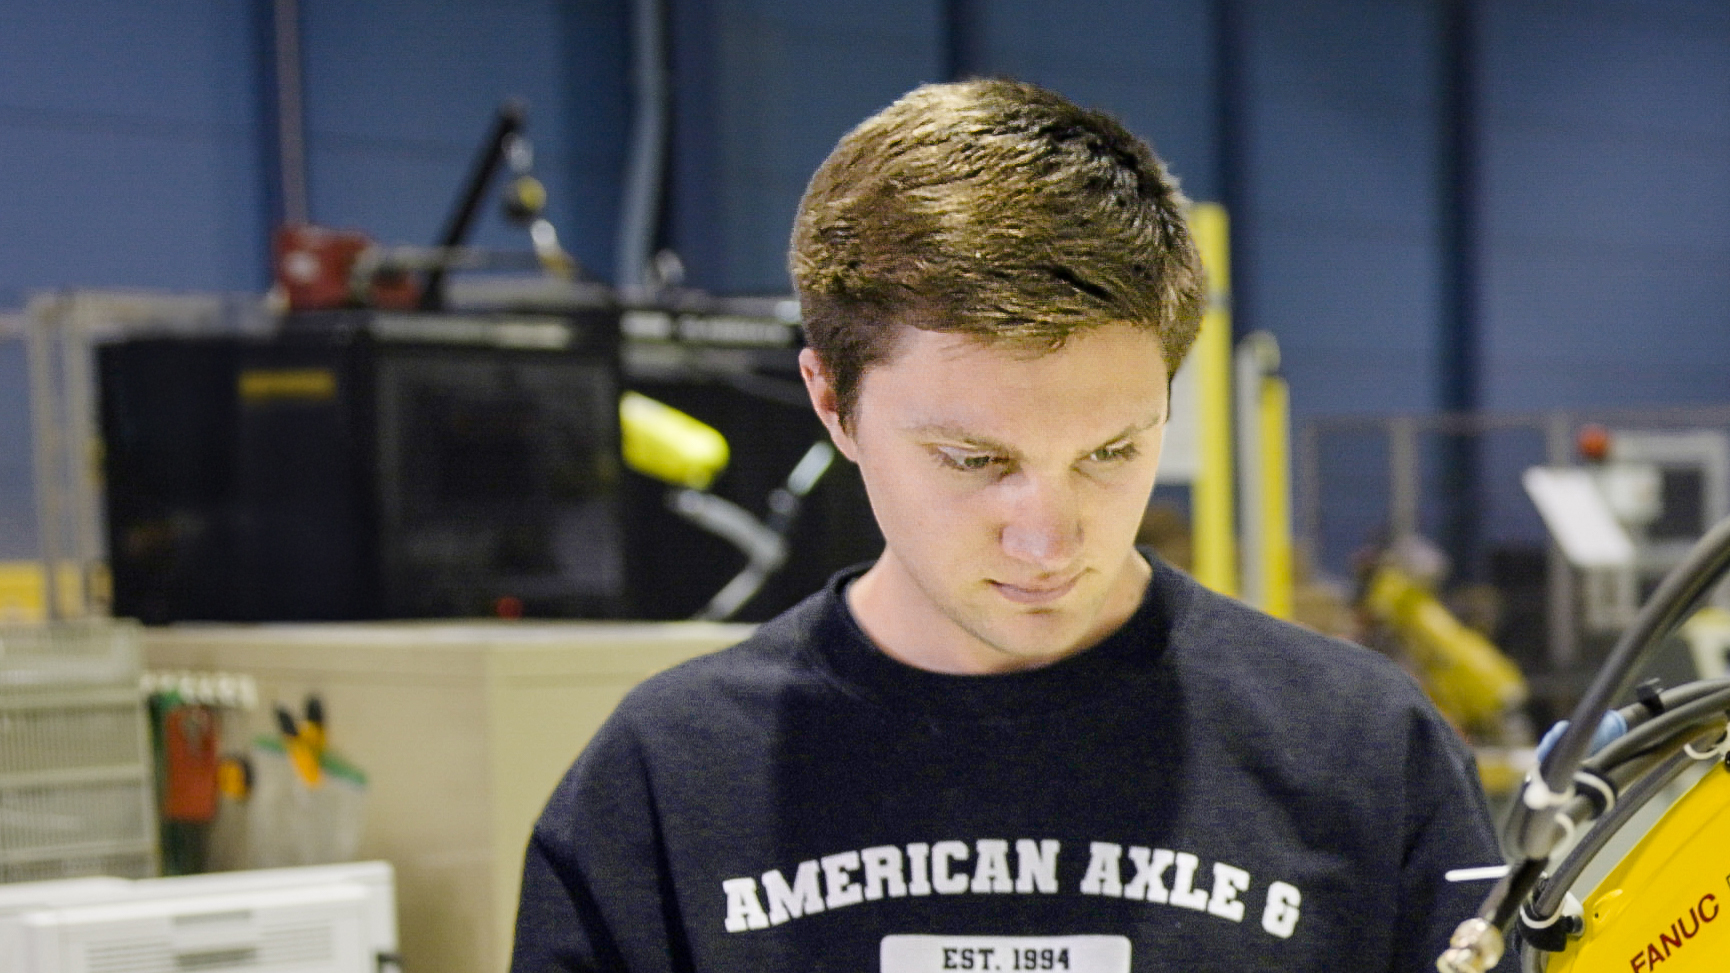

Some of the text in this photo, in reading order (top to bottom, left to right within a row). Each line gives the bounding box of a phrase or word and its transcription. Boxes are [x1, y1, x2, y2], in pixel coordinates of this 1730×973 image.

[722, 838, 1060, 933] AMERICAN
[1080, 841, 1251, 923] AXLE
[943, 948, 1071, 971] EST. 1994
